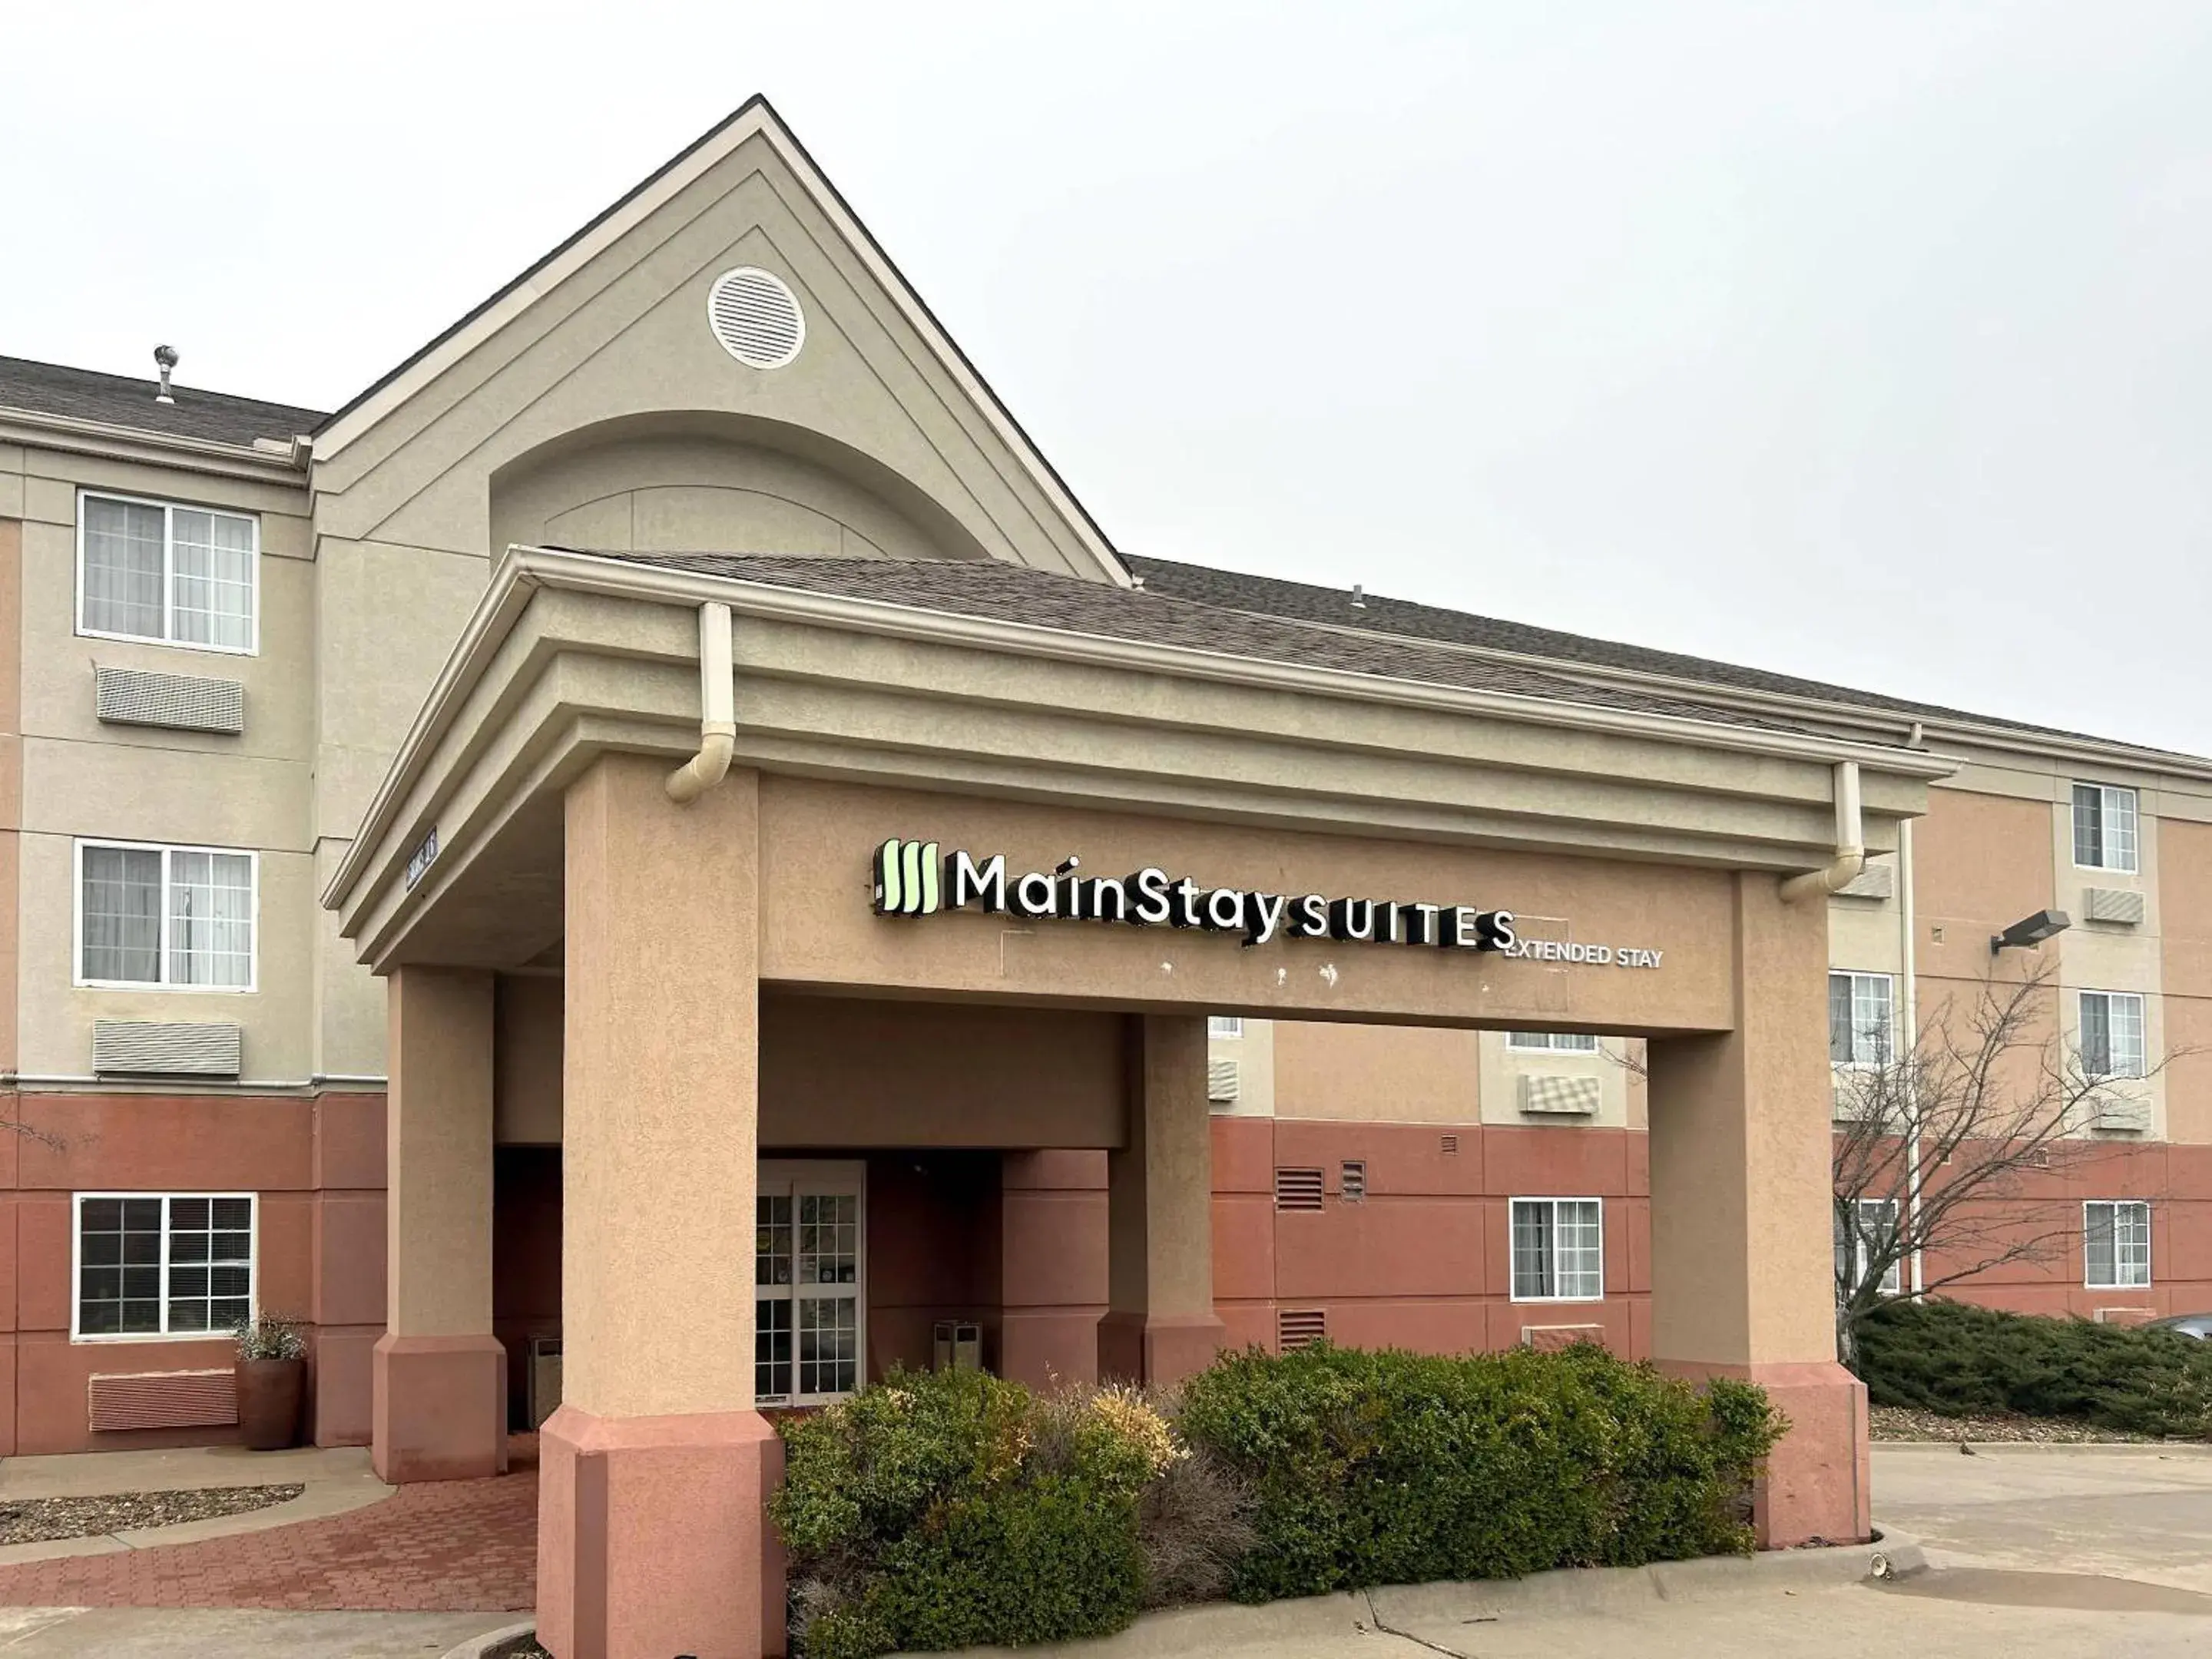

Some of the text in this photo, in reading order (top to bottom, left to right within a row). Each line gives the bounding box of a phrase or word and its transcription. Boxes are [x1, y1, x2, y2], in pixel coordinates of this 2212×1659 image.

[955, 850, 1515, 950] MainStay SUITES
[1616, 948, 1664, 968] STAY
